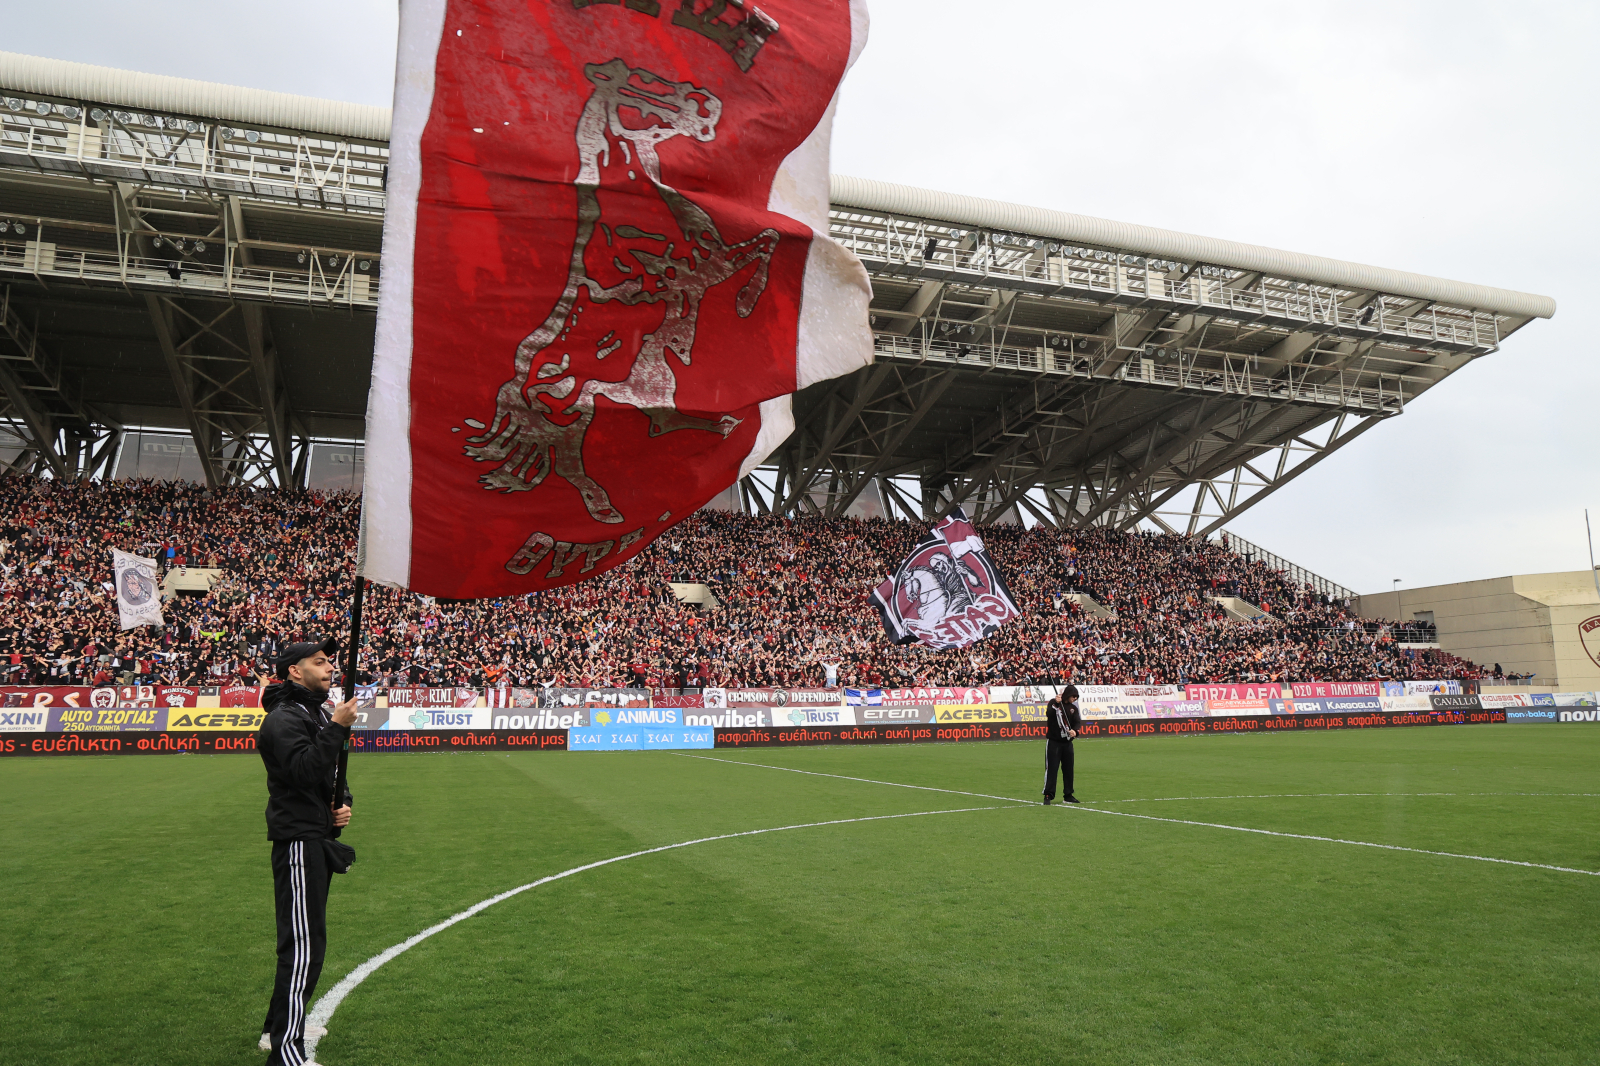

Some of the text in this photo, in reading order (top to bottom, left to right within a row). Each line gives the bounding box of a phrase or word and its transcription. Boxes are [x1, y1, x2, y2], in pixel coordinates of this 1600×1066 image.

[161, 687, 195, 696] MONSTERS
[791, 692, 841, 702] DEFENDERS
[1433, 697, 1478, 706] CAVALLO
[801, 709, 840, 722] TRUST
[1107, 705, 1145, 715] TAXINI
[97, 710, 158, 724] ΤΣΟΓΙΑΣ
[426, 710, 473, 725] TRUST
[494, 710, 583, 729] novibet
[617, 710, 676, 724] ANIMUS
[686, 709, 766, 727] novibet
[63, 722, 85, 731] 250
[913, 729, 931, 741] μας
[1136, 723, 1155, 736] μας
[541, 735, 565, 748] μας
